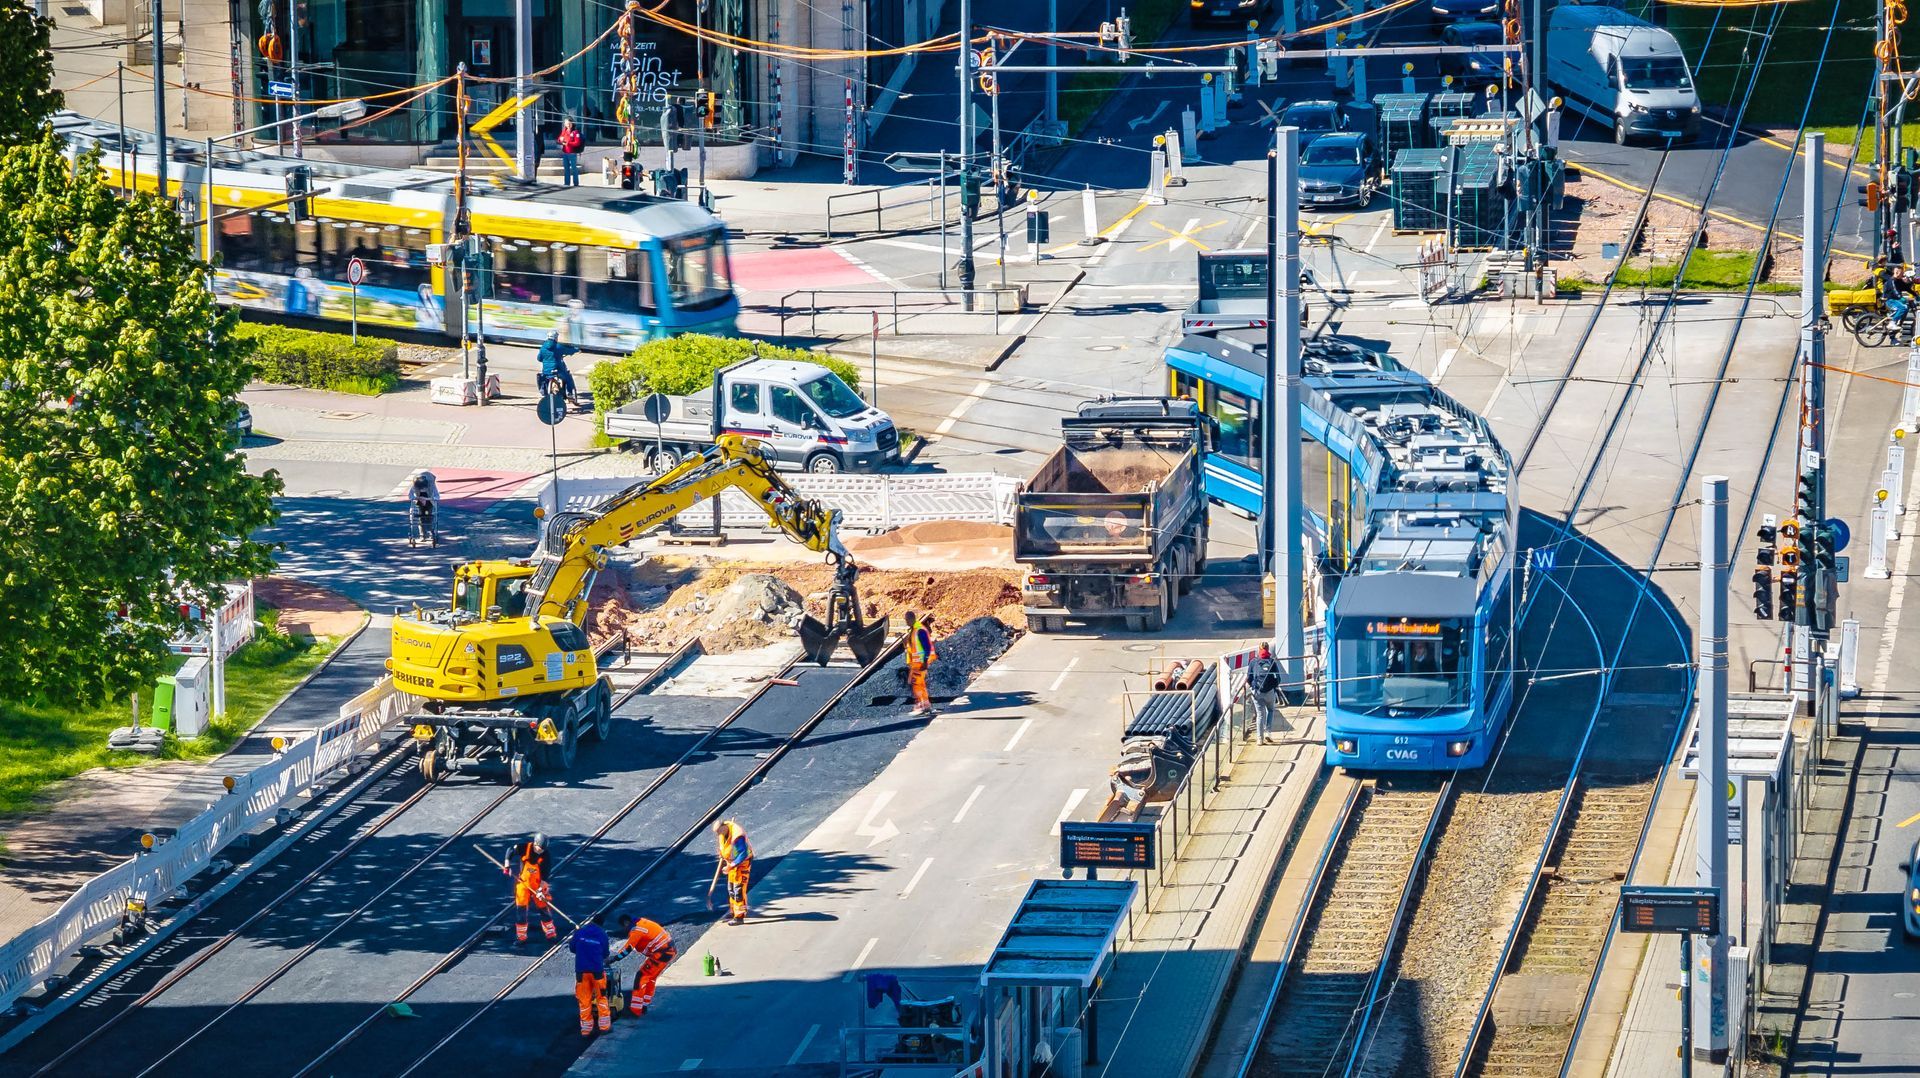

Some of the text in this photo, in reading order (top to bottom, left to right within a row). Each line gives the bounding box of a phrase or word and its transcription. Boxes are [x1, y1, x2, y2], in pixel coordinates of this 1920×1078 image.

[783, 432, 813, 440] EUROVIA
[636, 503, 677, 527] EUROVIA
[1535, 551, 1555, 568] W
[1376, 622, 1440, 634] Hauptbahnhof
[499, 653, 522, 663] 922
[566, 654, 576, 663] 20
[1394, 736, 1409, 745] 612
[1386, 749, 1418, 760] CVAG
